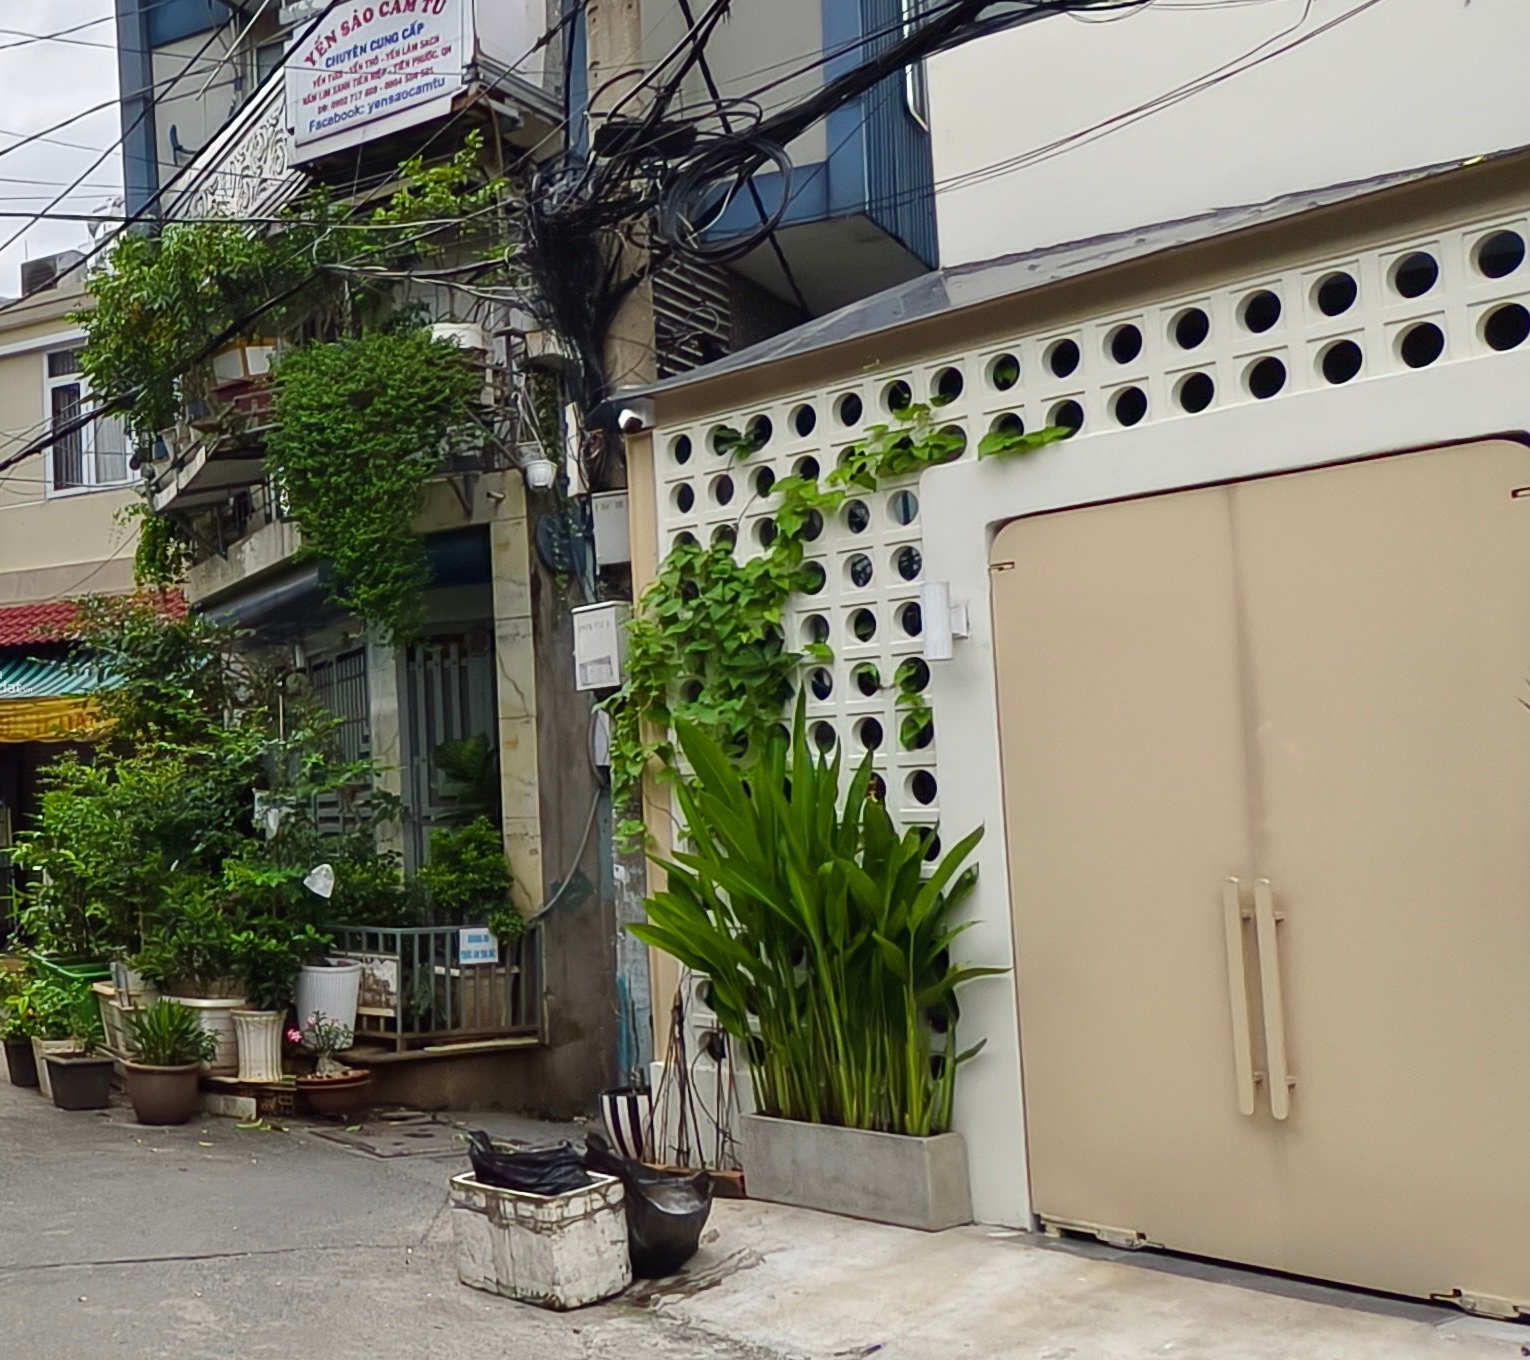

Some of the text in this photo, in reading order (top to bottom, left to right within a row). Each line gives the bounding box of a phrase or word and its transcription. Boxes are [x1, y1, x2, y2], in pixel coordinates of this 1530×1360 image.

[304, 30, 337, 67] YẾN
[325, 20, 425, 68] CHUYÊN CUNG CẤP
[308, 77, 445, 133] Facebook: yensaocamtu
